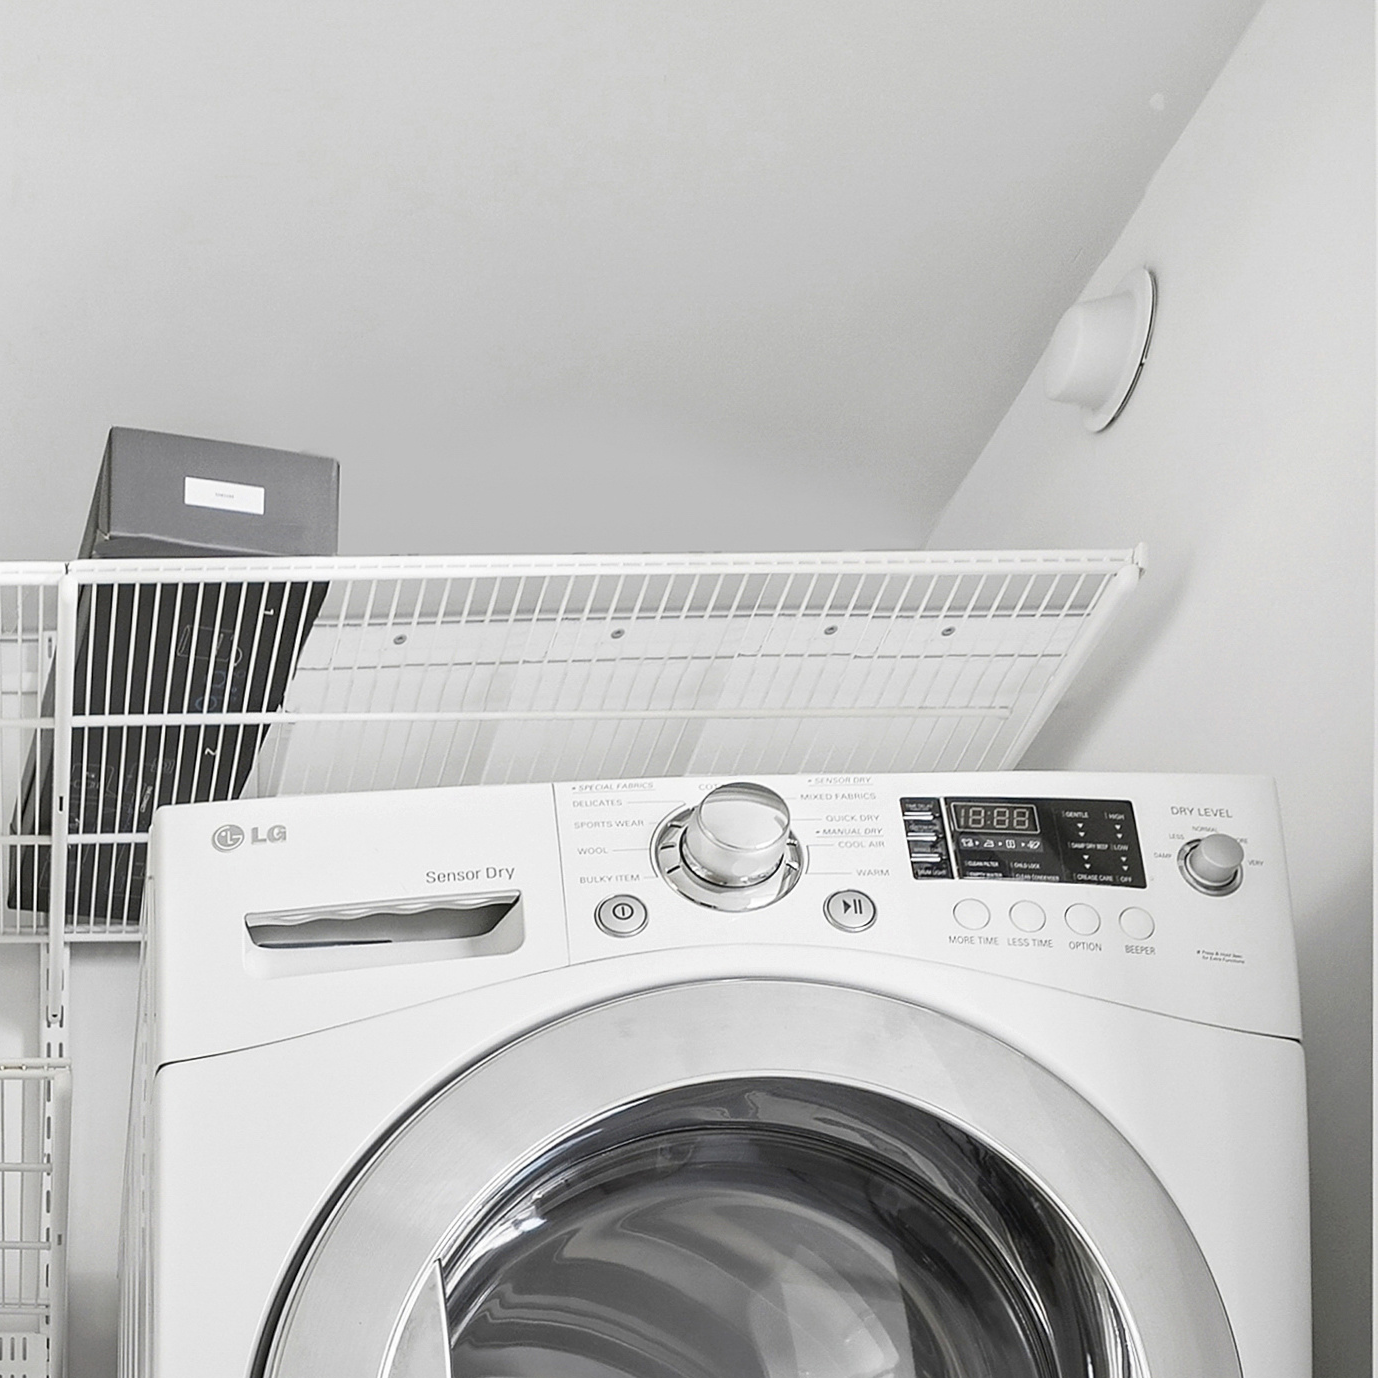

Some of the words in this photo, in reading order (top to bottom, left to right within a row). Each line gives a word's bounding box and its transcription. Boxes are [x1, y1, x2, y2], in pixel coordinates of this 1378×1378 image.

[800, 793, 832, 801] MIXED
[834, 792, 877, 801] FABRICS
[572, 799, 623, 808] DELICATES
[1065, 811, 1089, 819] GENTLE
[1171, 806, 1195, 816] DRY
[1197, 807, 1234, 819] LEVEL
[825, 814, 856, 822] QUICK
[859, 814, 880, 822] DRY
[573, 821, 610, 829] SPORTS
[614, 819, 645, 828] WEAR
[251, 824, 287, 845] LG
[861, 828, 883, 836] DRY
[837, 841, 866, 849] COOL
[868, 840, 886, 848] AIR
[577, 847, 609, 855] WOOL
[1248, 859, 1264, 867] VERY
[425, 869, 481, 884] Sensor
[485, 865, 516, 881] Dry
[856, 868, 890, 877] WARM
[579, 875, 613, 884] BULKY
[616, 873, 641, 883] ITEM
[948, 936, 975, 946] MORE
[978, 936, 999, 946] TIME
[1007, 938, 1031, 948] LESS
[1032, 938, 1054, 948] TIME
[1068, 941, 1103, 952] OPTION
[1124, 944, 1157, 956] BEEPER
